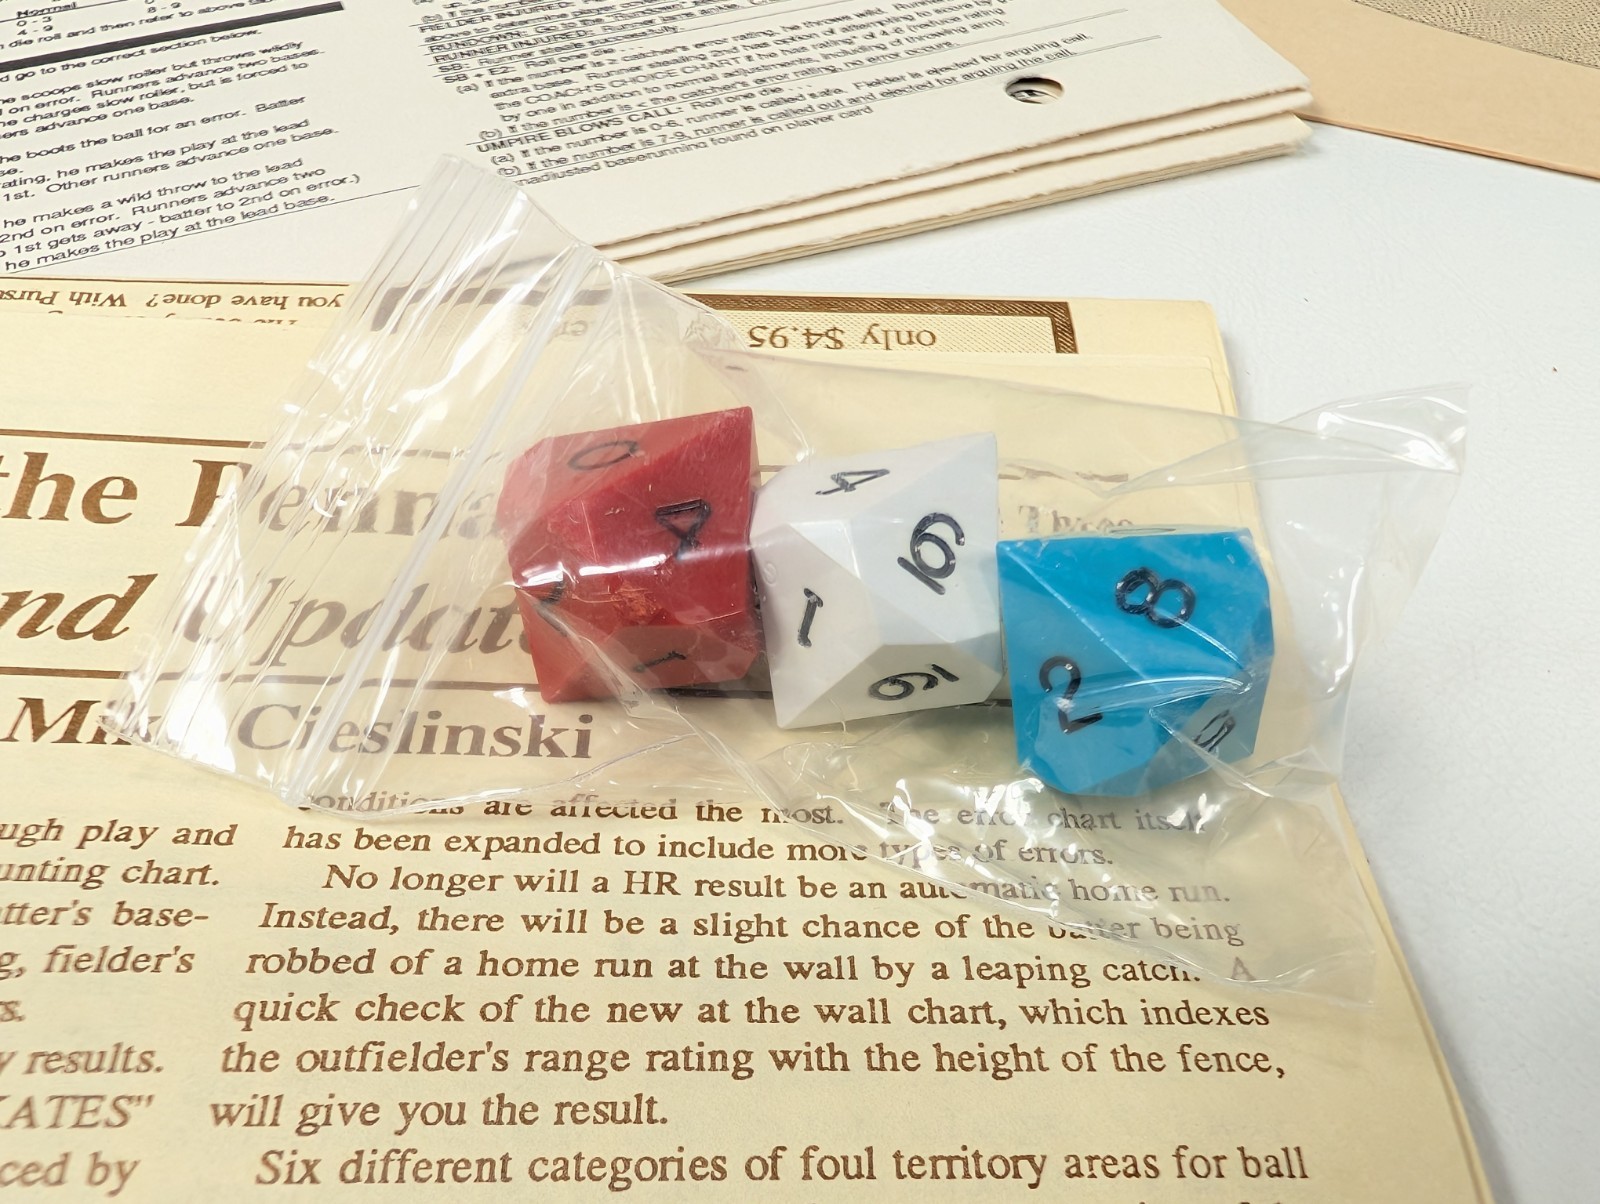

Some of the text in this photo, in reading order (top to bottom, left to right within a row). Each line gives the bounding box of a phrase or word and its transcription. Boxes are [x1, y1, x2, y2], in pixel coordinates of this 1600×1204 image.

[476, 131, 552, 152] UMPIRE
[554, 118, 624, 138] BLOWS
[0, 168, 325, 243] 2nd on error. Runners advance two
[4, 158, 303, 228] he makes a wild throw to the lead
[5, 195, 335, 271] he makes the play at the lead base.
[15, 242, 41, 254] 1st
[47, 233, 87, 249] gets
[93, 221, 142, 237] away
[159, 206, 212, 223] batter
[217, 201, 234, 212] to
[238, 191, 273, 206] 2nd
[279, 188, 301, 197] on
[68, 290, 127, 307] With
[145, 293, 221, 309] done?
[231, 293, 287, 310] have
[298, 293, 344, 308] you
[747, 323, 937, 350] only $4.95
[815, 468, 890, 495] 4
[656, 499, 711, 560] 4
[1115, 567, 1196, 629] 8
[798, 588, 823, 648] 1
[1039, 655, 1103, 735] 2
[237, 703, 593, 758] Cieslinski
[483, 800, 532, 816] are
[550, 795, 679, 820] affected
[695, 800, 743, 822] the
[1047, 808, 1122, 830] chart
[74, 819, 160, 850] play
[172, 824, 238, 846] and
[282, 826, 342, 850] has
[354, 828, 430, 852] been
[444, 832, 600, 860] expanded
[614, 836, 646, 856] to
[657, 836, 774, 859] include
[1018, 846, 1113, 864] errors.
[121, 860, 219, 886] chart.
[321, 864, 1231, 903] No longer will a HR result be an home run.
[112, 900, 209, 927] base-
[258, 902, 1244, 946] Instead, there will be a slight chance of the being
[42, 944, 195, 973] fielder's
[245, 947, 376, 974] robbed
[390, 948, 435, 975] of
[444, 956, 462, 975] a
[476, 950, 580, 977] home
[594, 959, 653, 978] run
[668, 956, 700, 978] at
[714, 954, 768, 979] the
[783, 955, 858, 980] wall
[871, 955, 915, 988] by
[932, 962, 950, 980] a
[962, 955, 1091, 989] leaping
[234, 992, 1270, 1032] quick check of the new at the wall chart, which indexes
[22, 1042, 164, 1074] results.
[222, 1041, 1286, 1080] the outfielder's range rating with the height of the fence,
[210, 1092, 668, 1136] will give you the result.
[86, 1151, 141, 1198] by
[255, 1144, 1310, 1192] Six different categories of foul territory areas for ball
